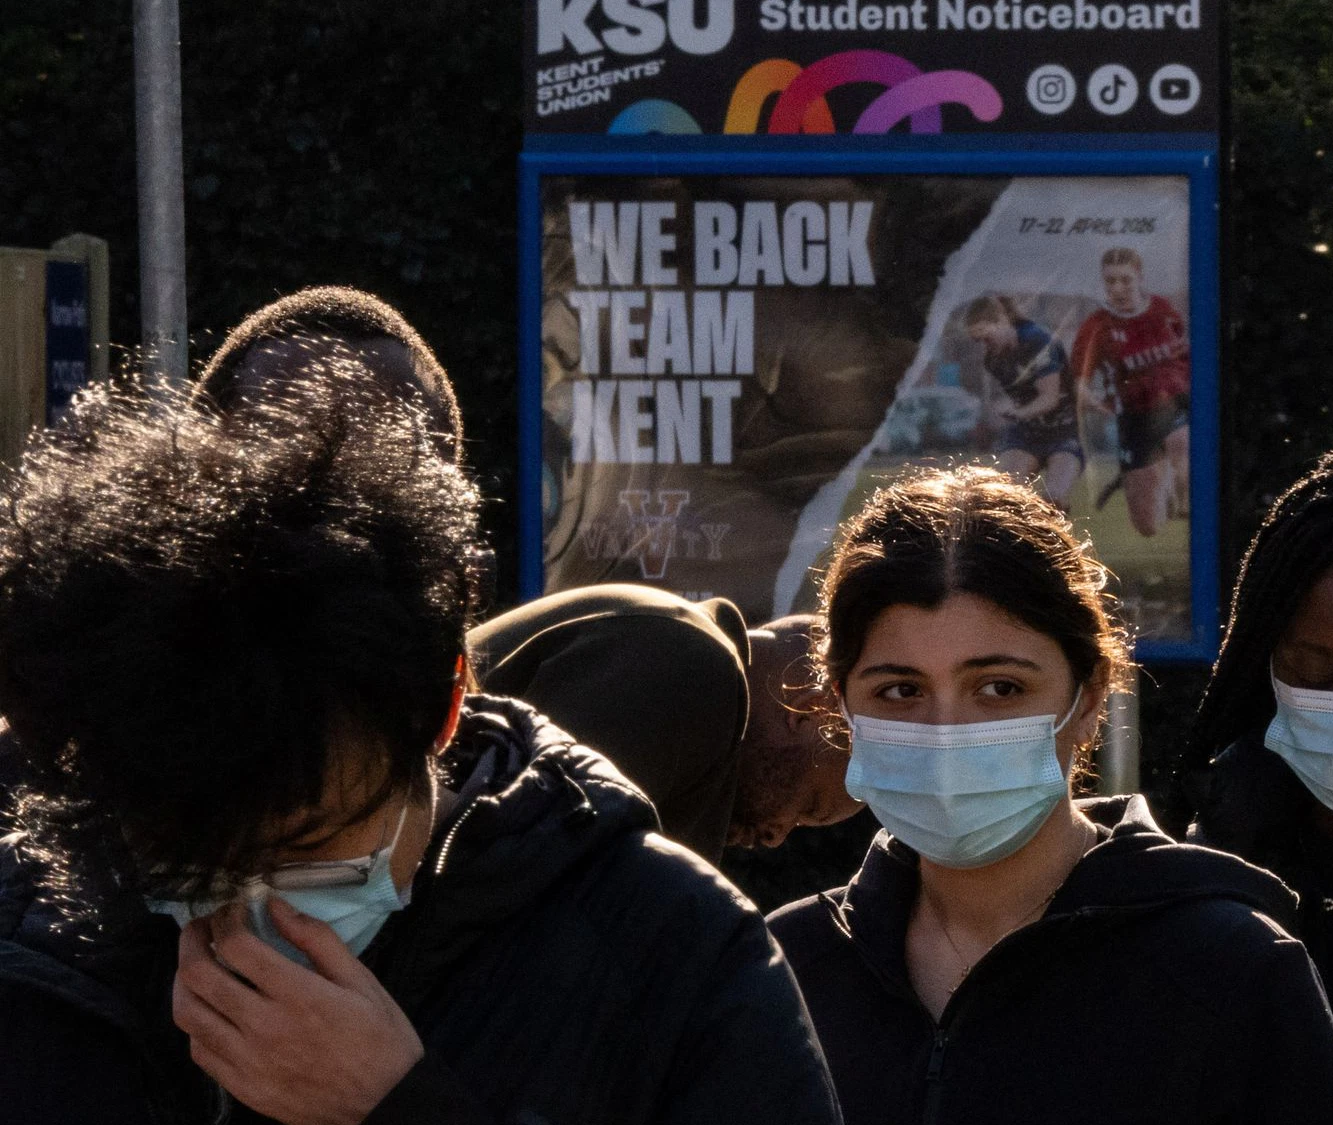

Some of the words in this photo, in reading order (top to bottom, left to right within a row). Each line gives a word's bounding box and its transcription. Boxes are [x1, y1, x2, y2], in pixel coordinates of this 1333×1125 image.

[537, 0, 735, 55] KSU
[759, 0, 928, 31] Student
[937, 0, 1200, 30] Noticeboard
[536, 56, 604, 86] KENT
[537, 87, 611, 117] UNION
[568, 201, 677, 286] WE
[695, 200, 875, 286] BACK
[569, 291, 755, 375] TEAM
[572, 380, 741, 464] KENT
